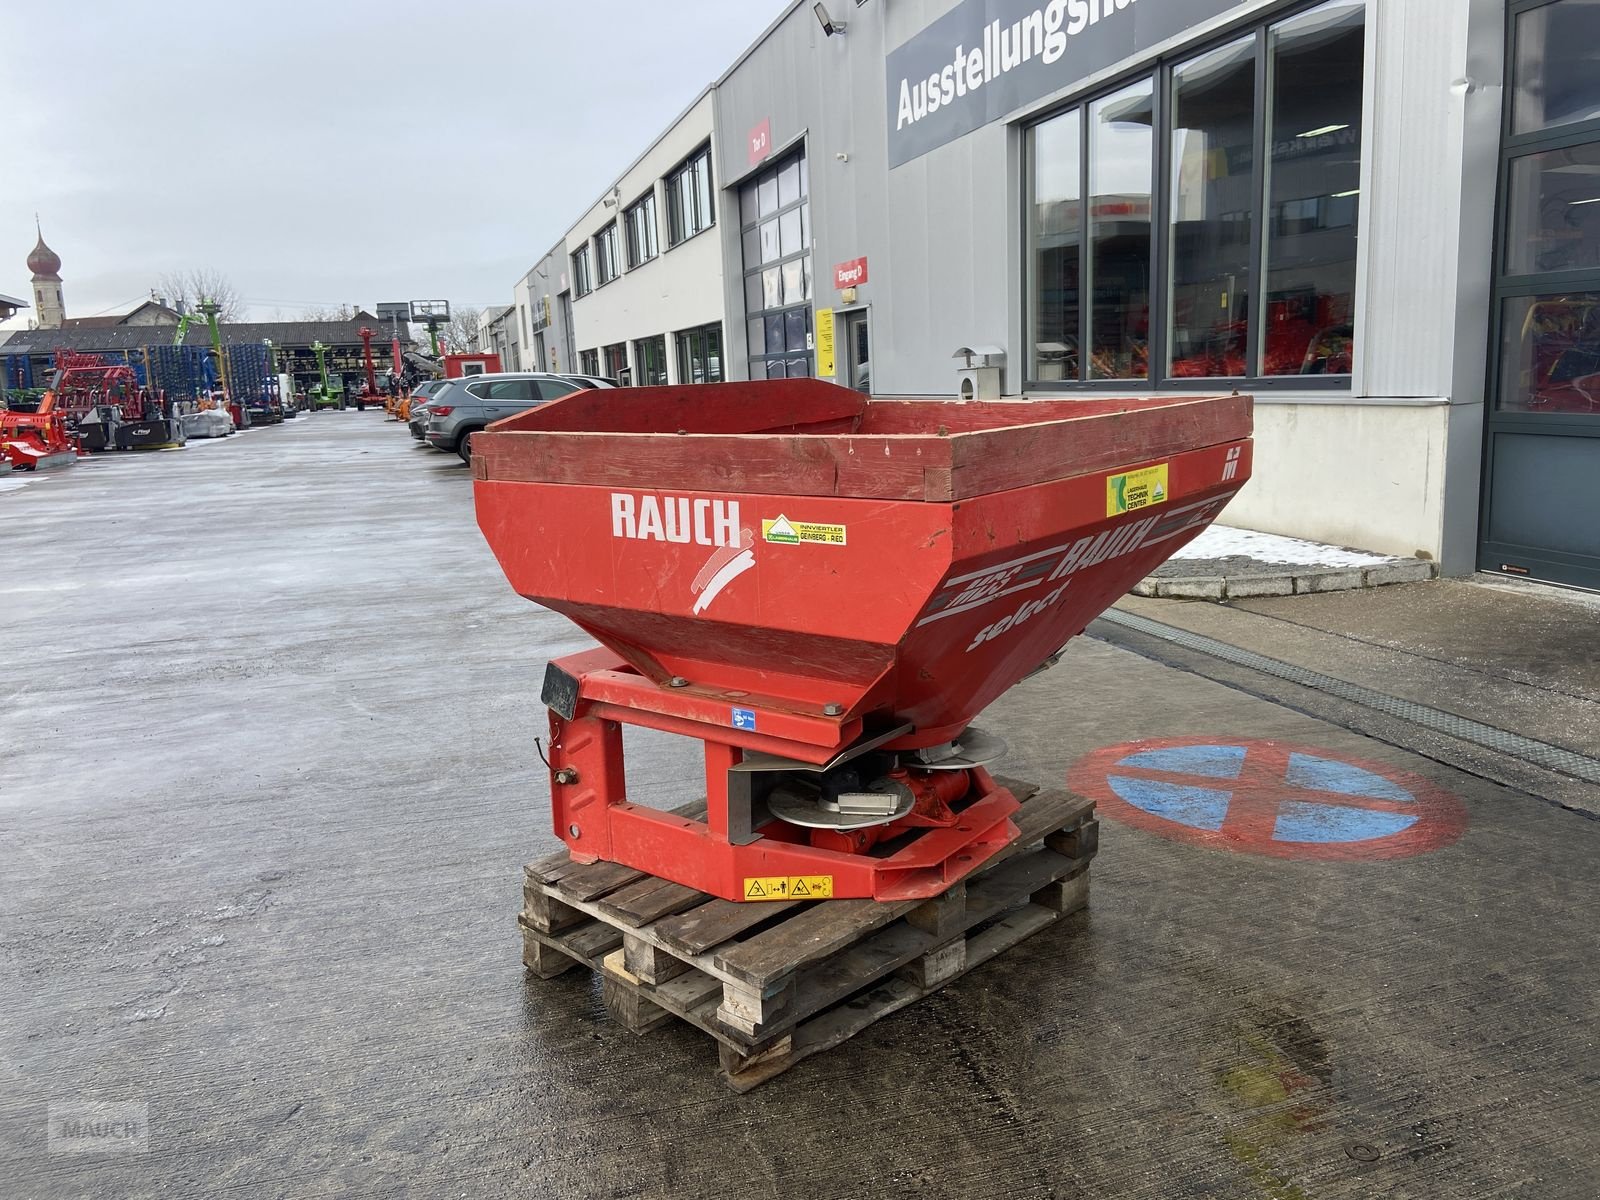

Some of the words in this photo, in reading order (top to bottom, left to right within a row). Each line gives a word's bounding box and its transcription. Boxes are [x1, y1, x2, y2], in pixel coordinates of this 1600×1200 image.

[838, 268, 858, 282] Eingang
[857, 264, 863, 277] D
[1127, 490, 1149, 502] TECHNIK
[1127, 499, 1147, 510] CENTER
[611, 493, 741, 549] RAUCH
[800, 524, 843, 533] INNVIERTLER
[800, 532, 827, 542] GEINBERG
[831, 535, 844, 543] RIED
[1047, 513, 1163, 582] RAUCH
[965, 578, 1072, 653] select
